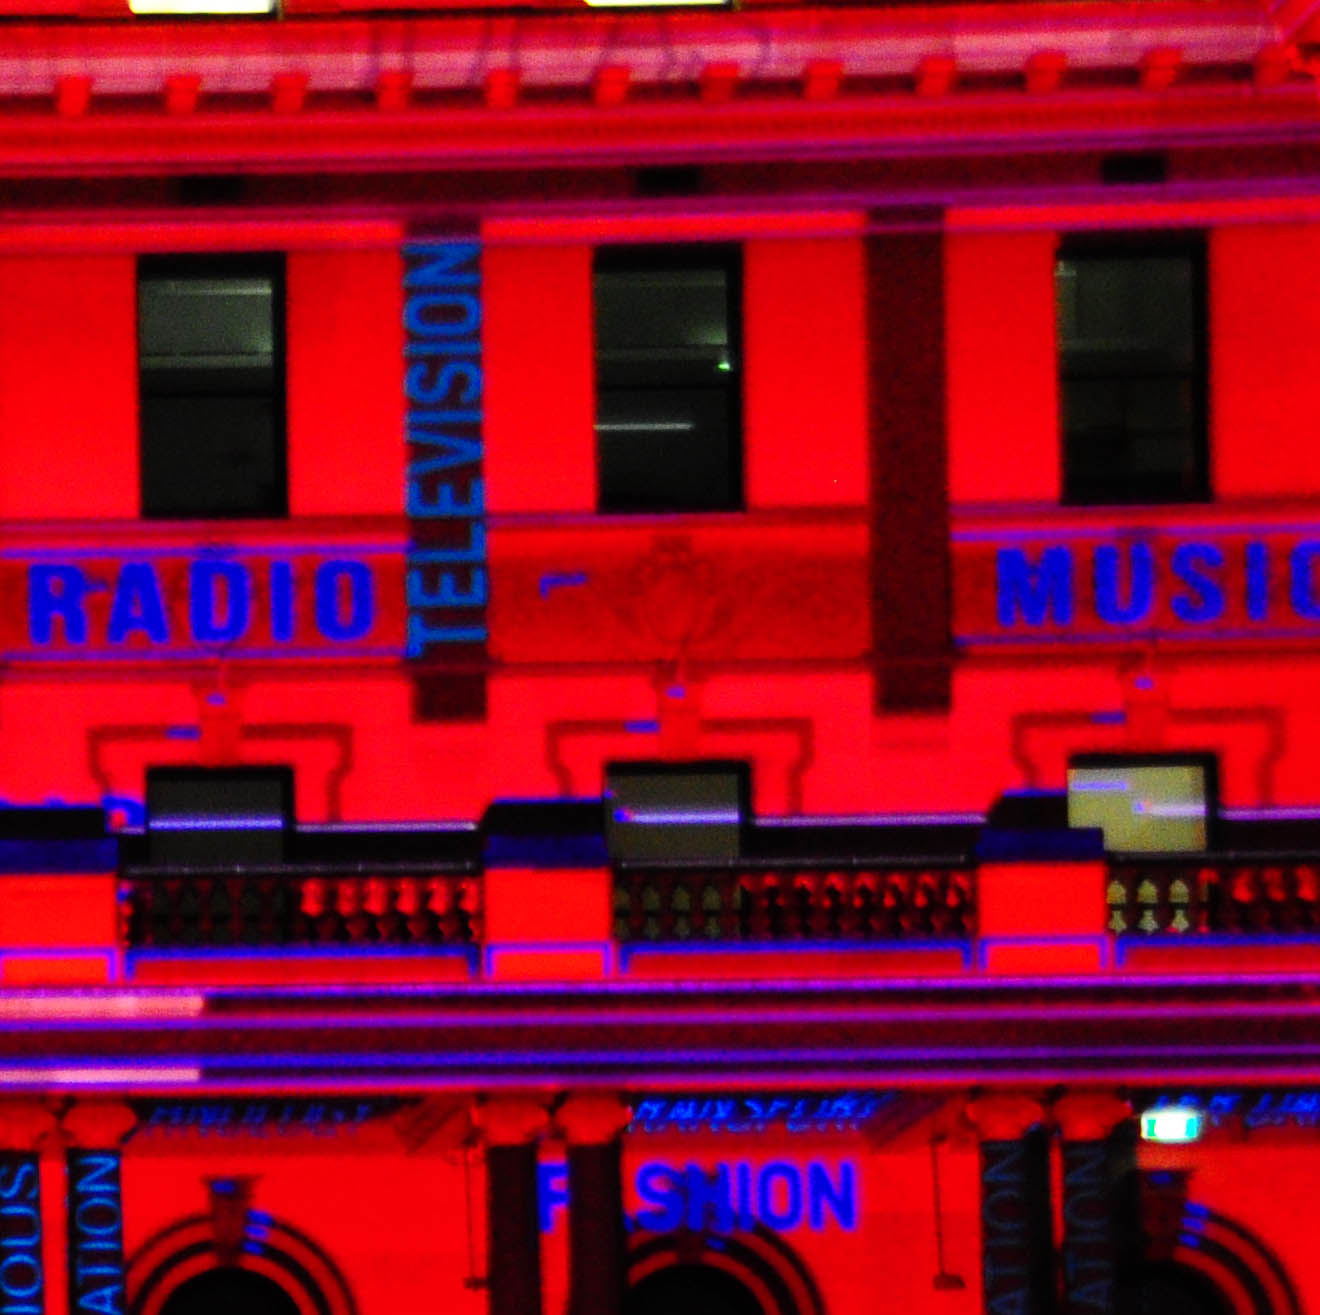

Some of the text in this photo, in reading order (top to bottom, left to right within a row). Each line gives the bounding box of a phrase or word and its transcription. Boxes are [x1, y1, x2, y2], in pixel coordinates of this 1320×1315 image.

[403, 235, 488, 660] TELEVISION
[26, 557, 376, 646] RADIO
[542, 1160, 860, 1232] FSHION
